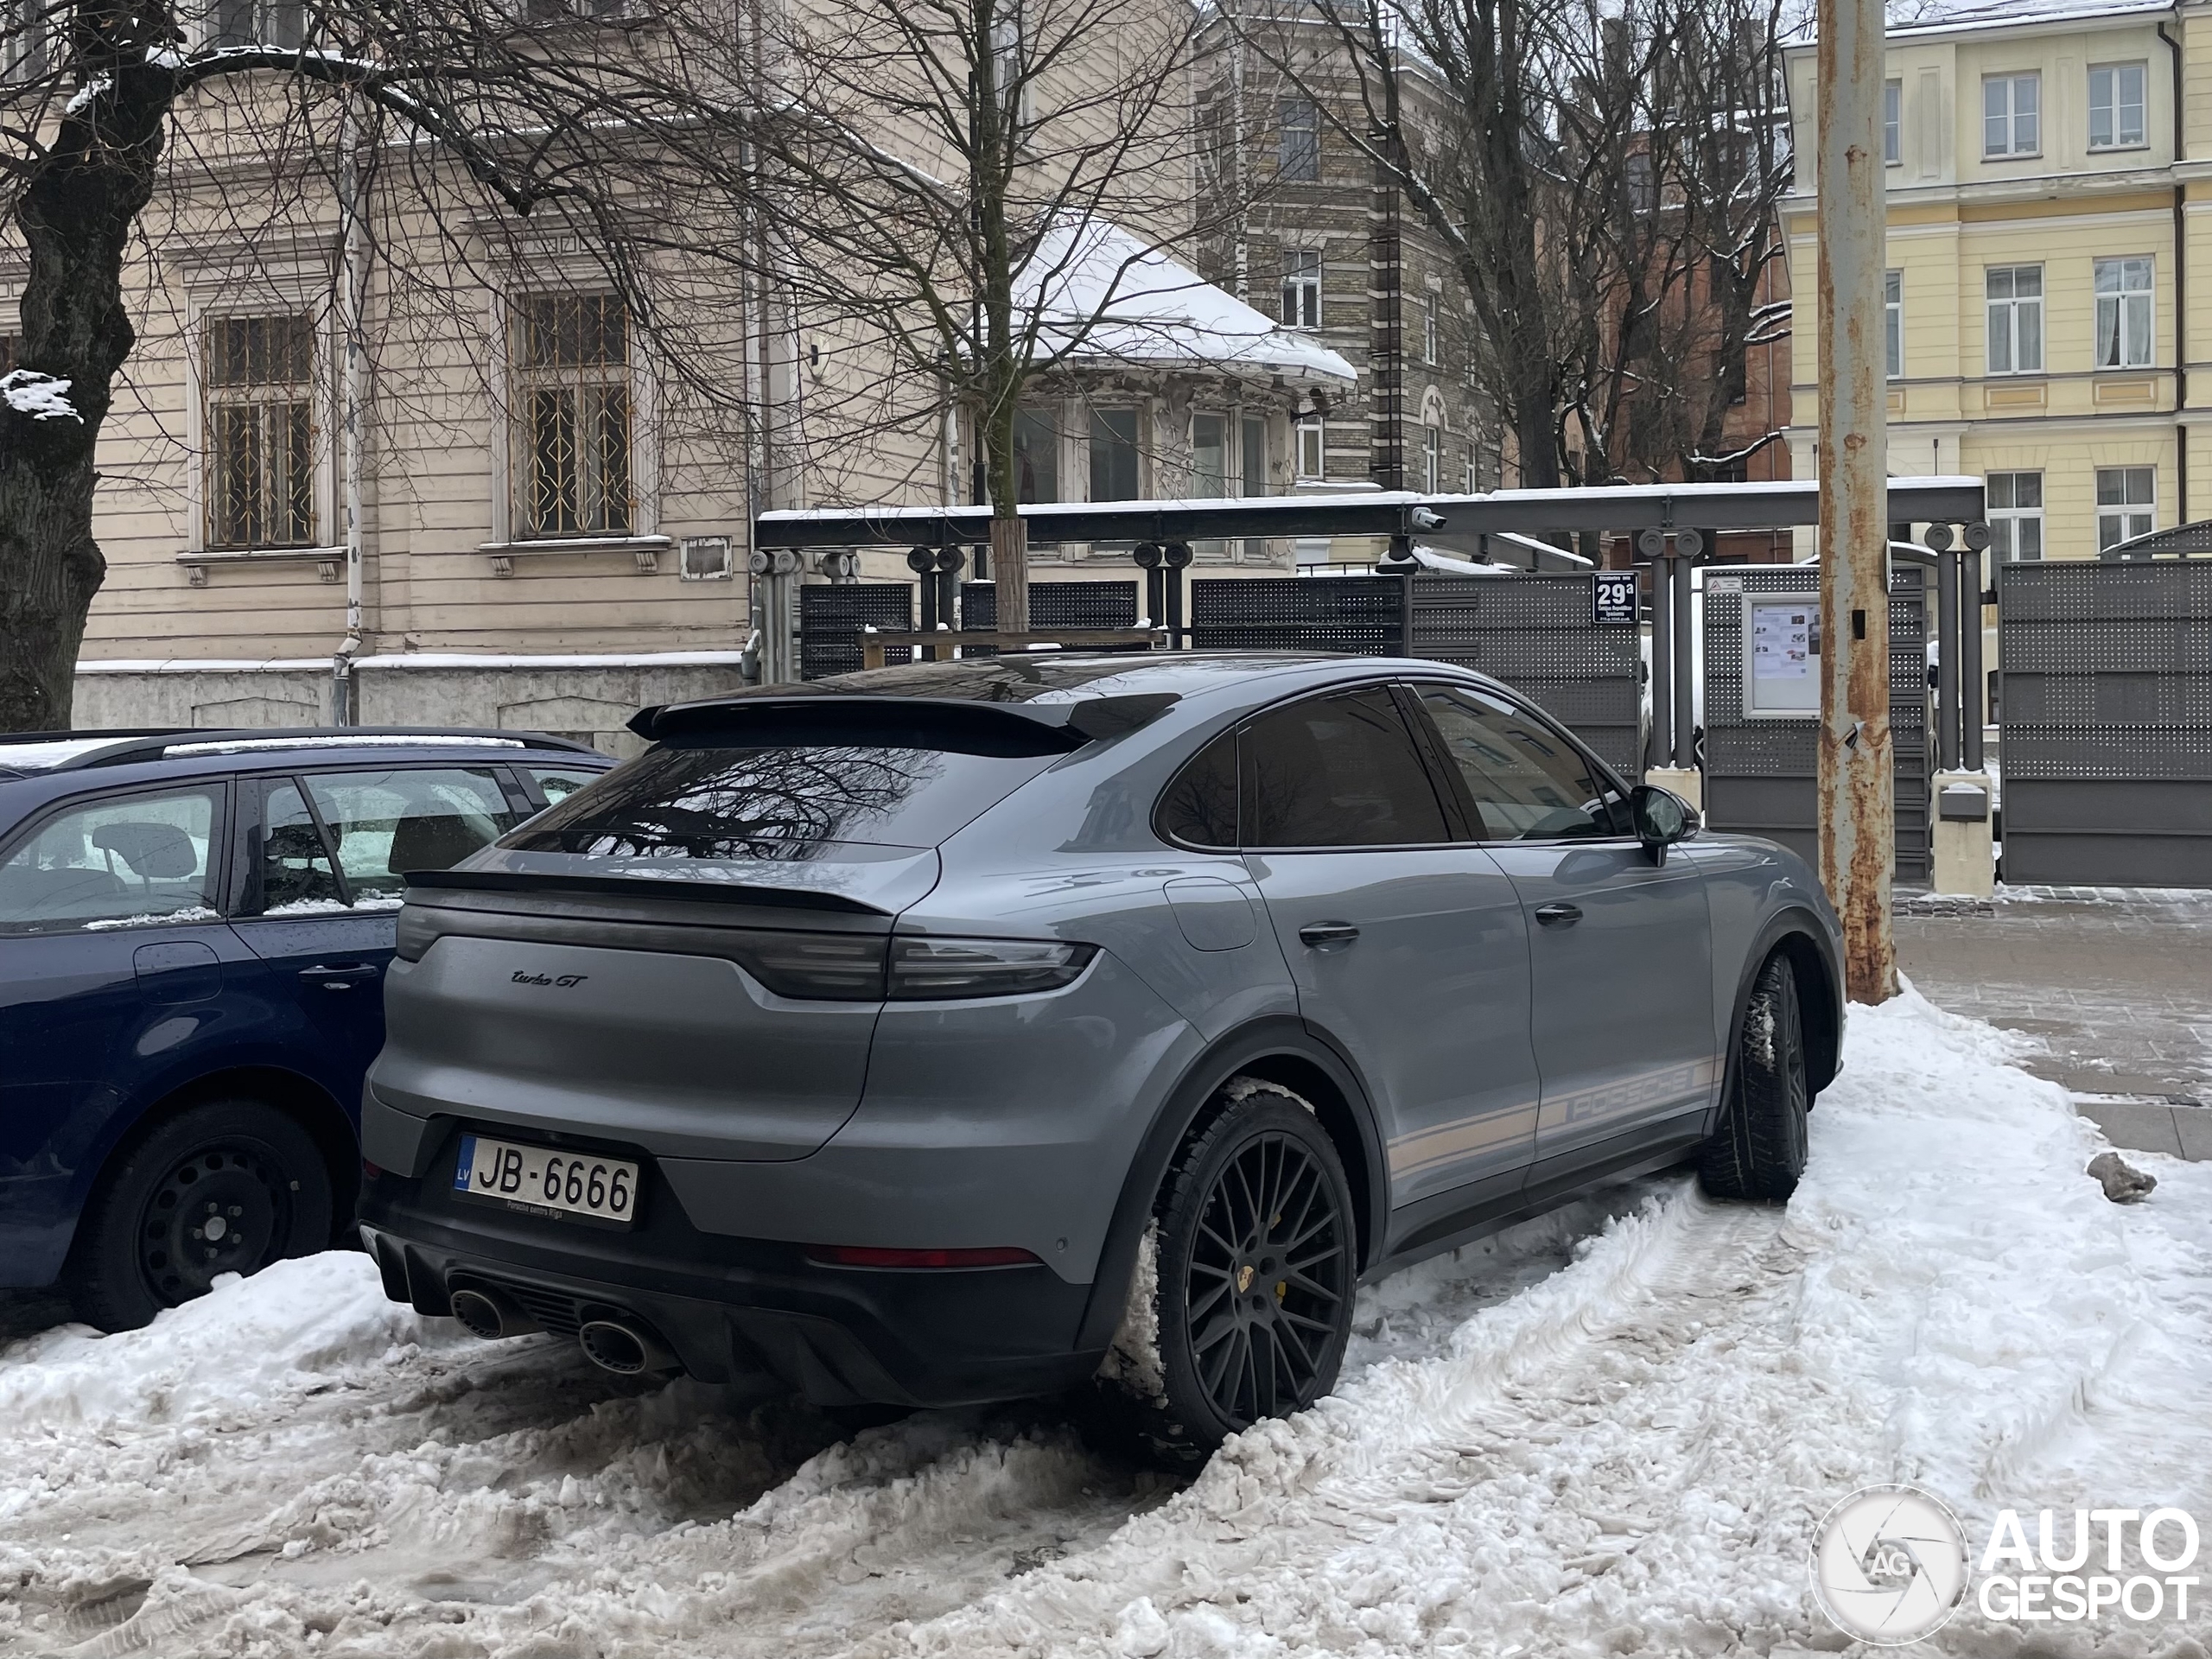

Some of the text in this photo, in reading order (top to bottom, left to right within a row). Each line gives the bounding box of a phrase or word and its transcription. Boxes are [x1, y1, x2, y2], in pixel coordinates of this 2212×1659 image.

[1598, 583, 1633, 605] 29a
[556, 975, 588, 988] GT
[1573, 1069, 1688, 1120] PORSCHE
[457, 1168, 469, 1181] LV
[479, 1147, 630, 1212] JB-6666
